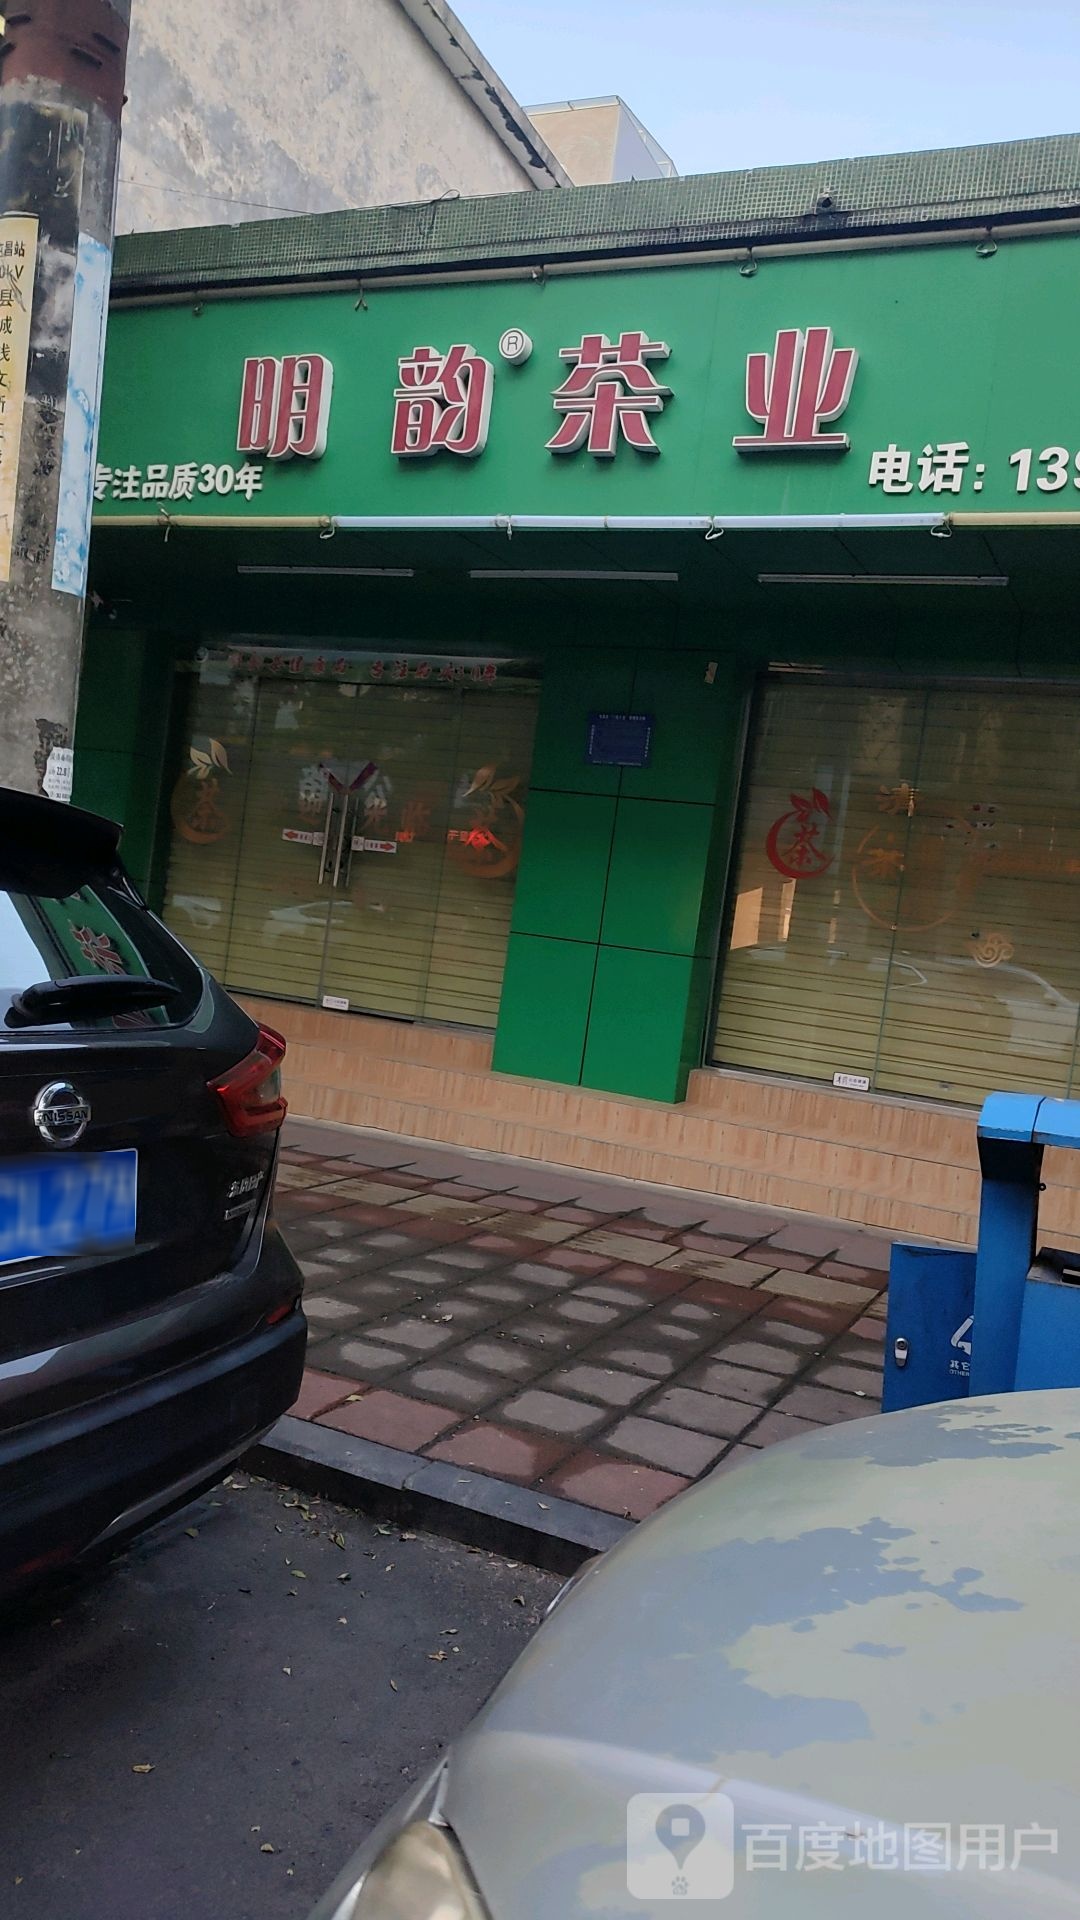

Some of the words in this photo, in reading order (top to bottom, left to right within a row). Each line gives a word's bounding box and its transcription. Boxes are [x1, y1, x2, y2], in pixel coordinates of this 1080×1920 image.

[93, 462, 263, 501] 专注品质30年
[42, 1109, 88, 1126] NISSAN
